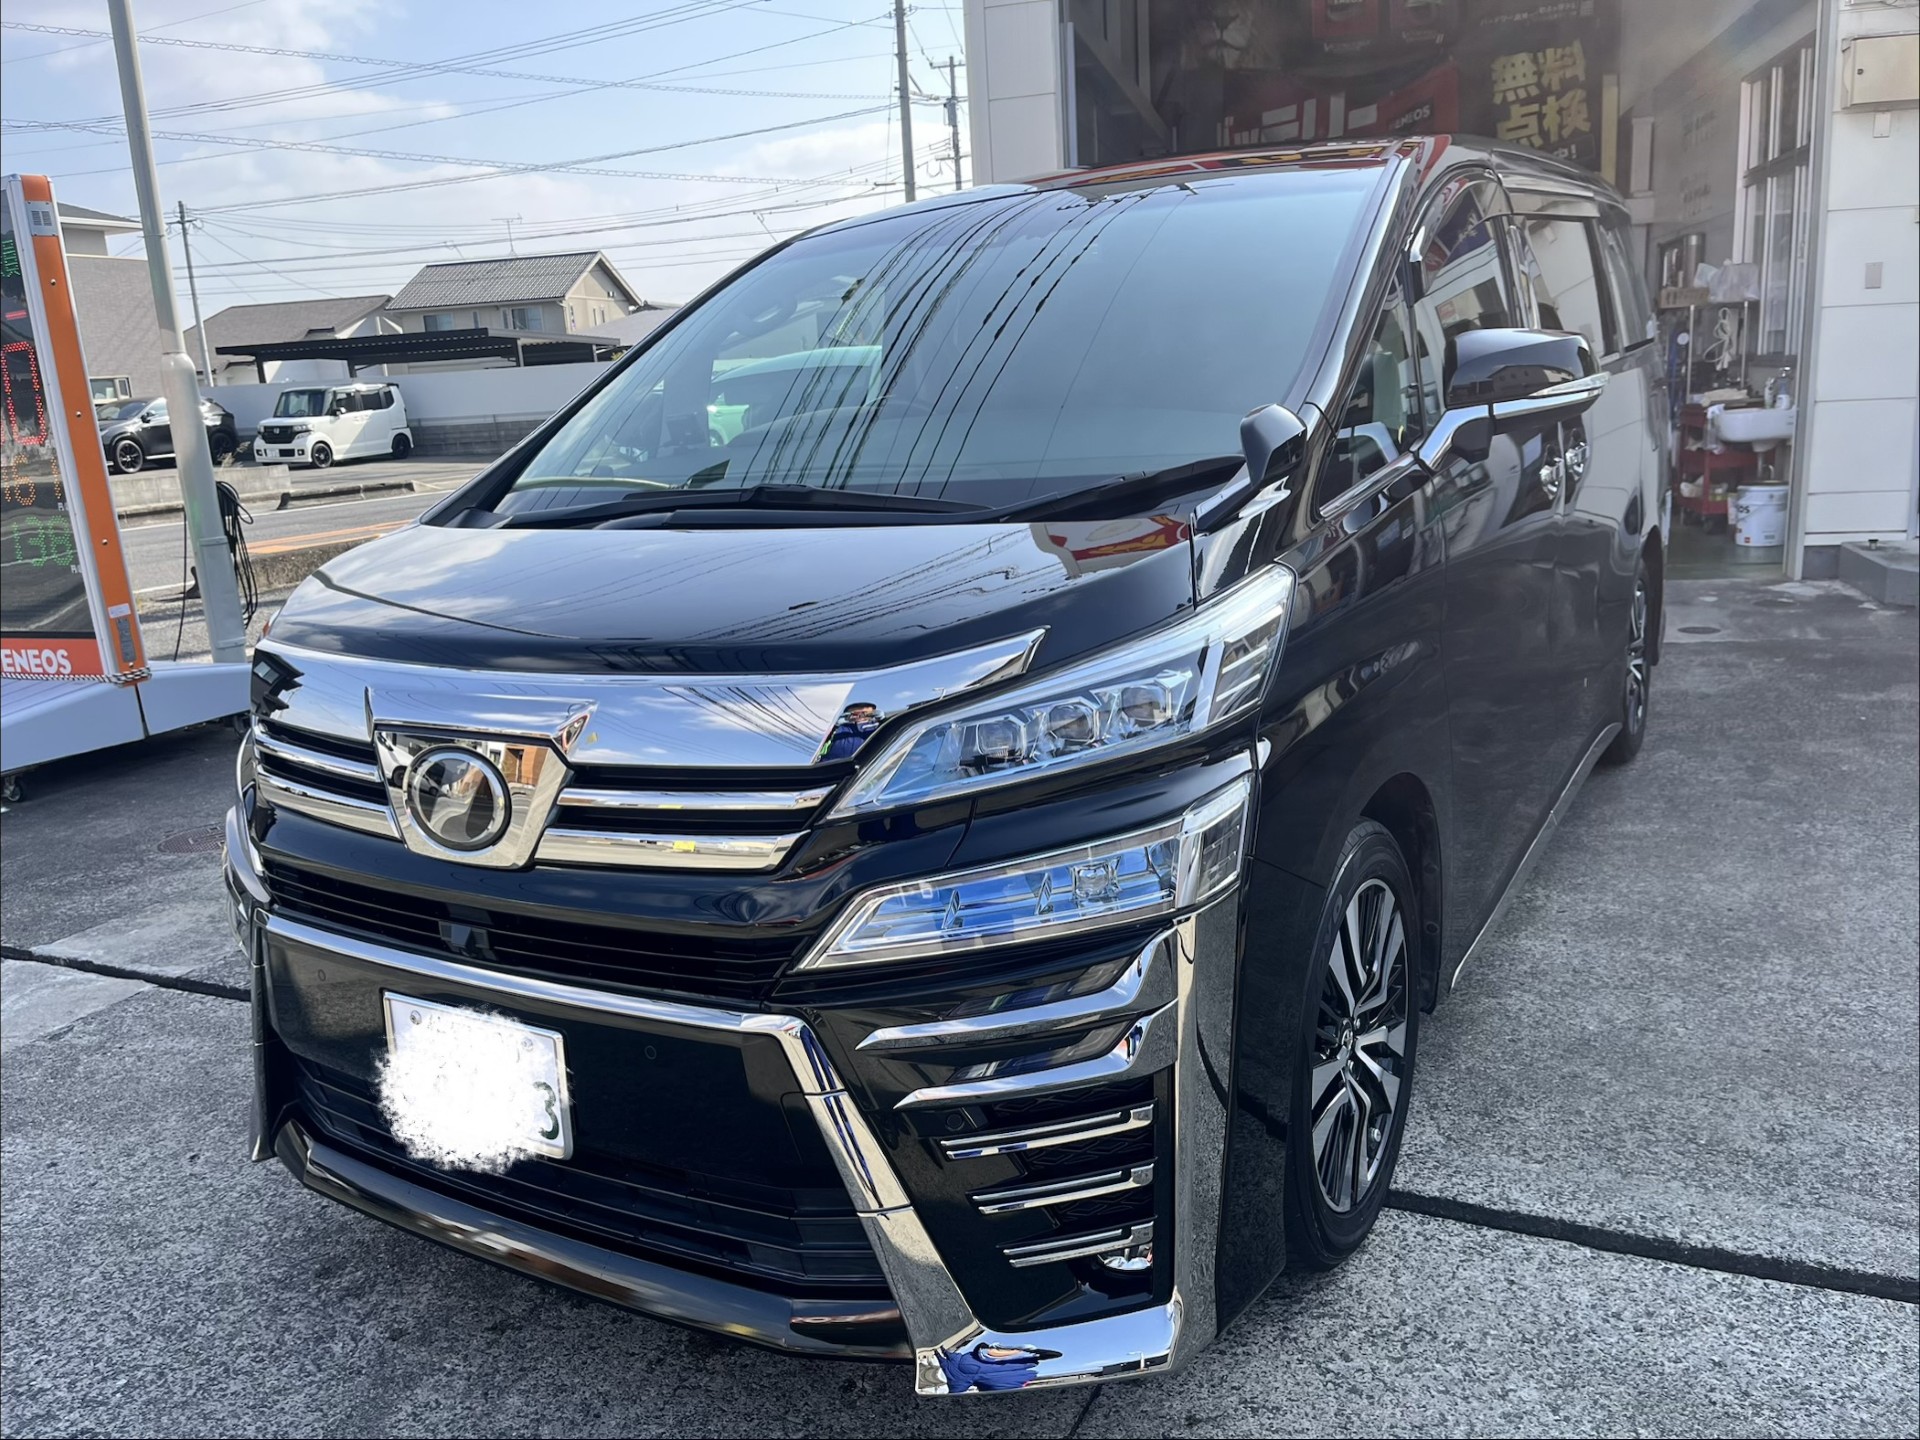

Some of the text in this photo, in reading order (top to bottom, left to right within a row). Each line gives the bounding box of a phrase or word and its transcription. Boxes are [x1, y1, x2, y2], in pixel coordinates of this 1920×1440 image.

[1491, 38, 1585, 104] 無料
[1496, 88, 1591, 149] 点検
[0, 341, 48, 446] 0
[11, 515, 73, 567] 138
[0, 648, 72, 675] ENEOS
[532, 1081, 560, 1140] 3
